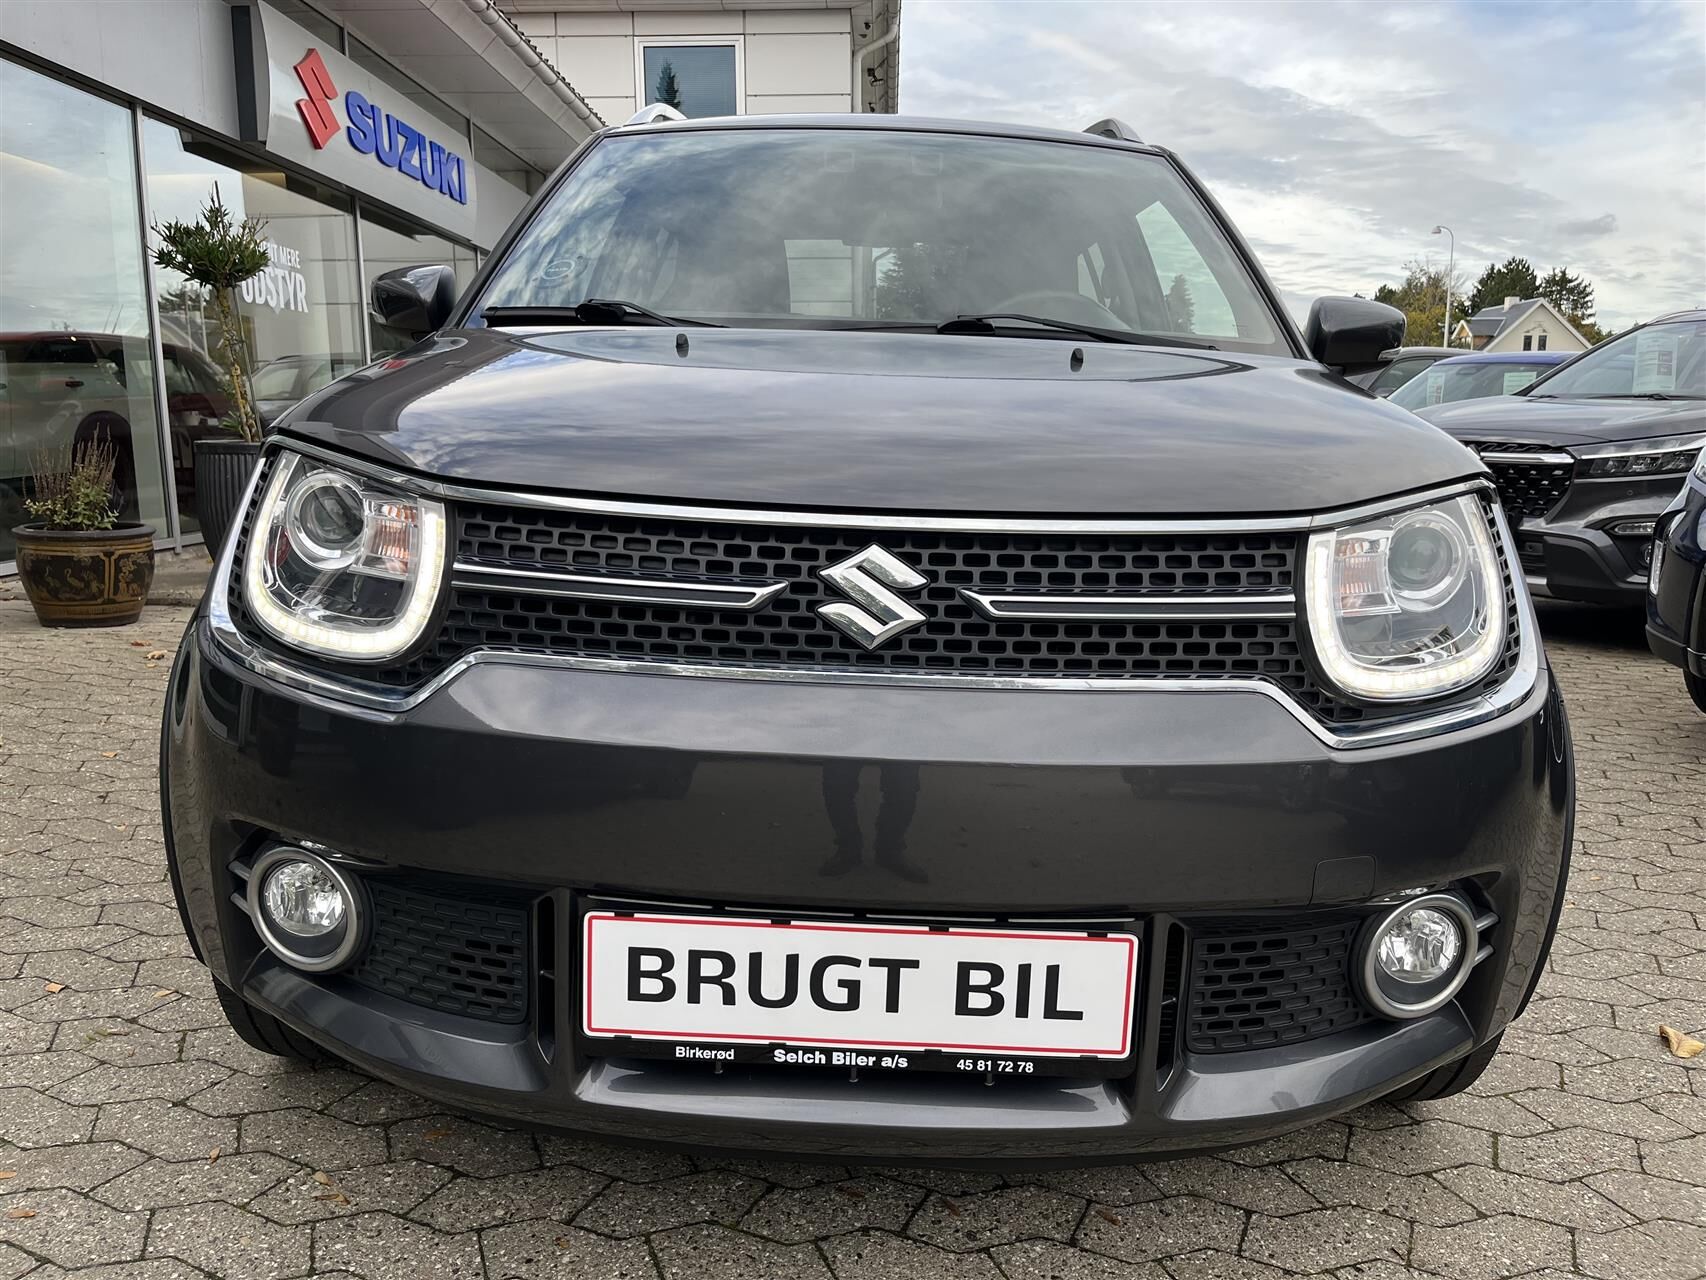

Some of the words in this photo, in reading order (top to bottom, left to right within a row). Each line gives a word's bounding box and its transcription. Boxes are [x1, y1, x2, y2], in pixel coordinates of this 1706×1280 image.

[345, 91, 467, 205] SUZUKI
[280, 246, 301, 269] MERE
[627, 946, 920, 1014] BRUGT
[954, 961, 1084, 1021] BIL
[675, 1045, 735, 1060] Birkerød
[773, 1049, 826, 1065] Selch
[832, 1051, 877, 1067] Biler
[881, 1054, 909, 1069] a/s
[956, 1059, 974, 1071] 45
[976, 1060, 993, 1072] 81
[997, 1061, 1014, 1073] 72
[1017, 1062, 1034, 1073] 78
